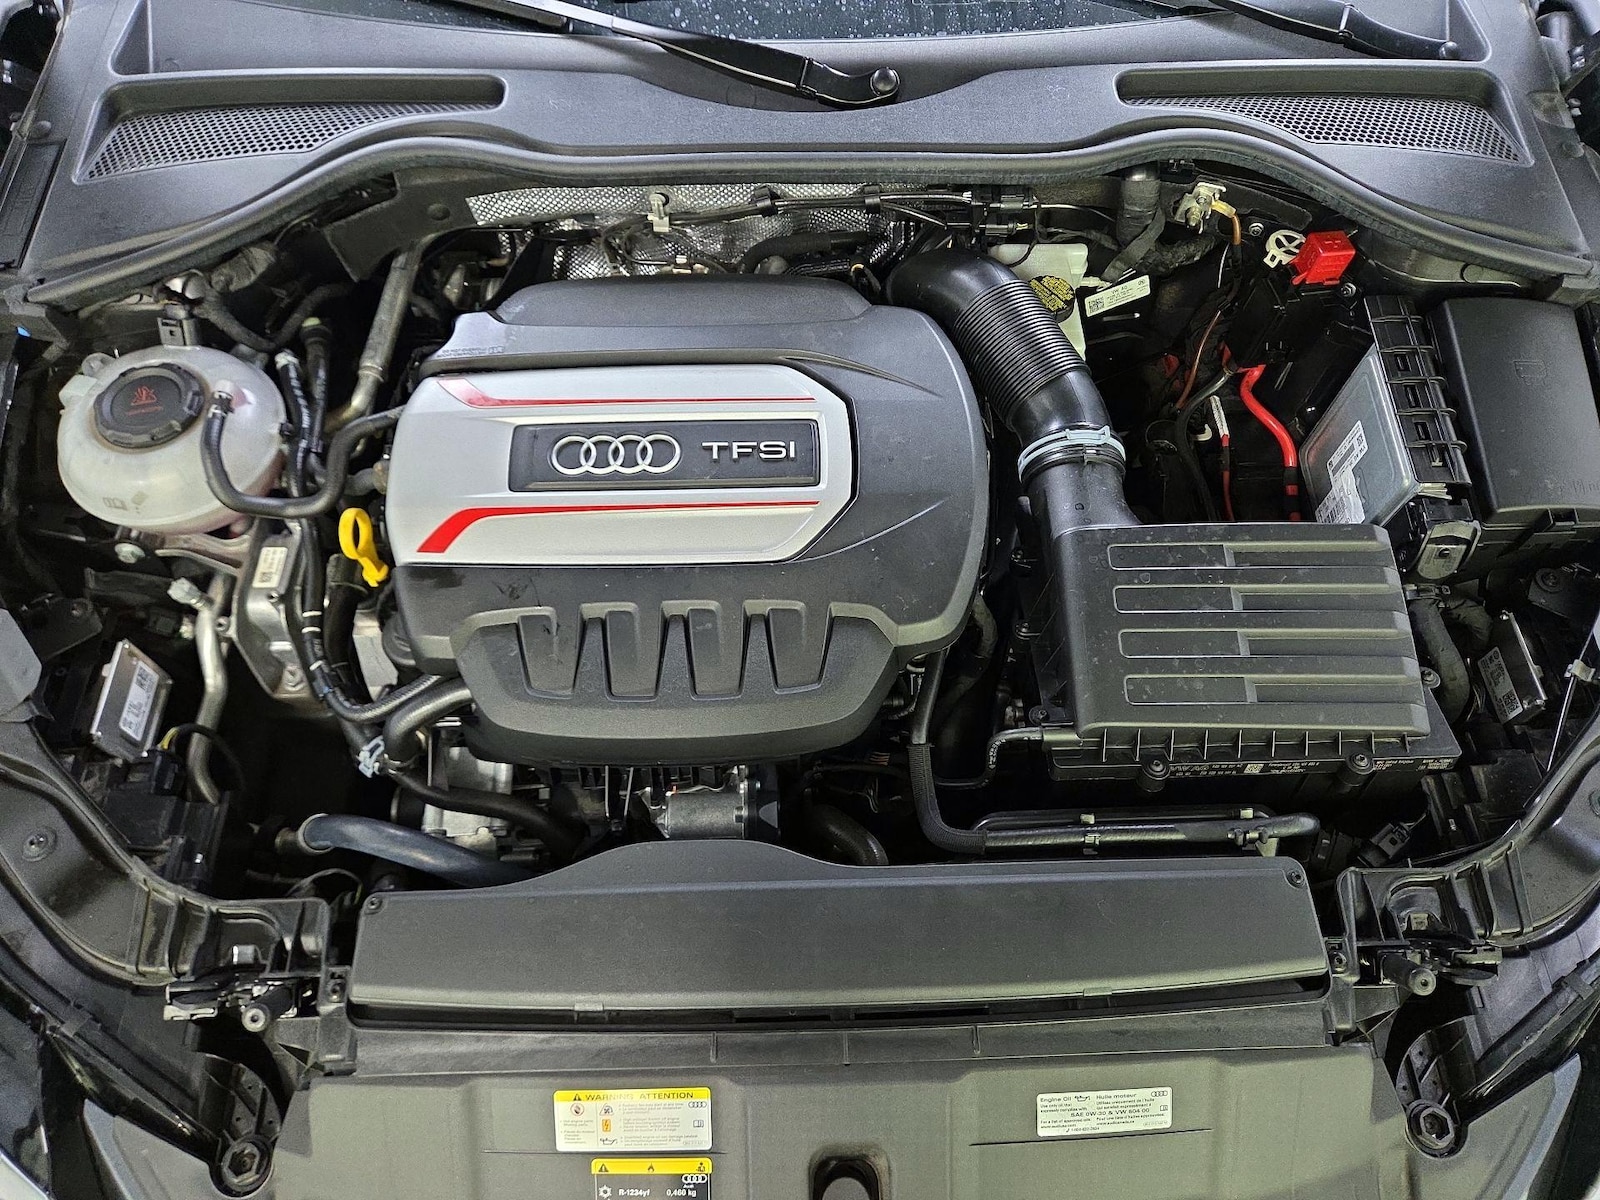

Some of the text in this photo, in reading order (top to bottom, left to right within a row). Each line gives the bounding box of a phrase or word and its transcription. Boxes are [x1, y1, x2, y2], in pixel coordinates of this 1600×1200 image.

[701, 441, 796, 461] TFSI
[639, 1092, 694, 1100] ATTENTION
[688, 1188, 697, 1197] kg
